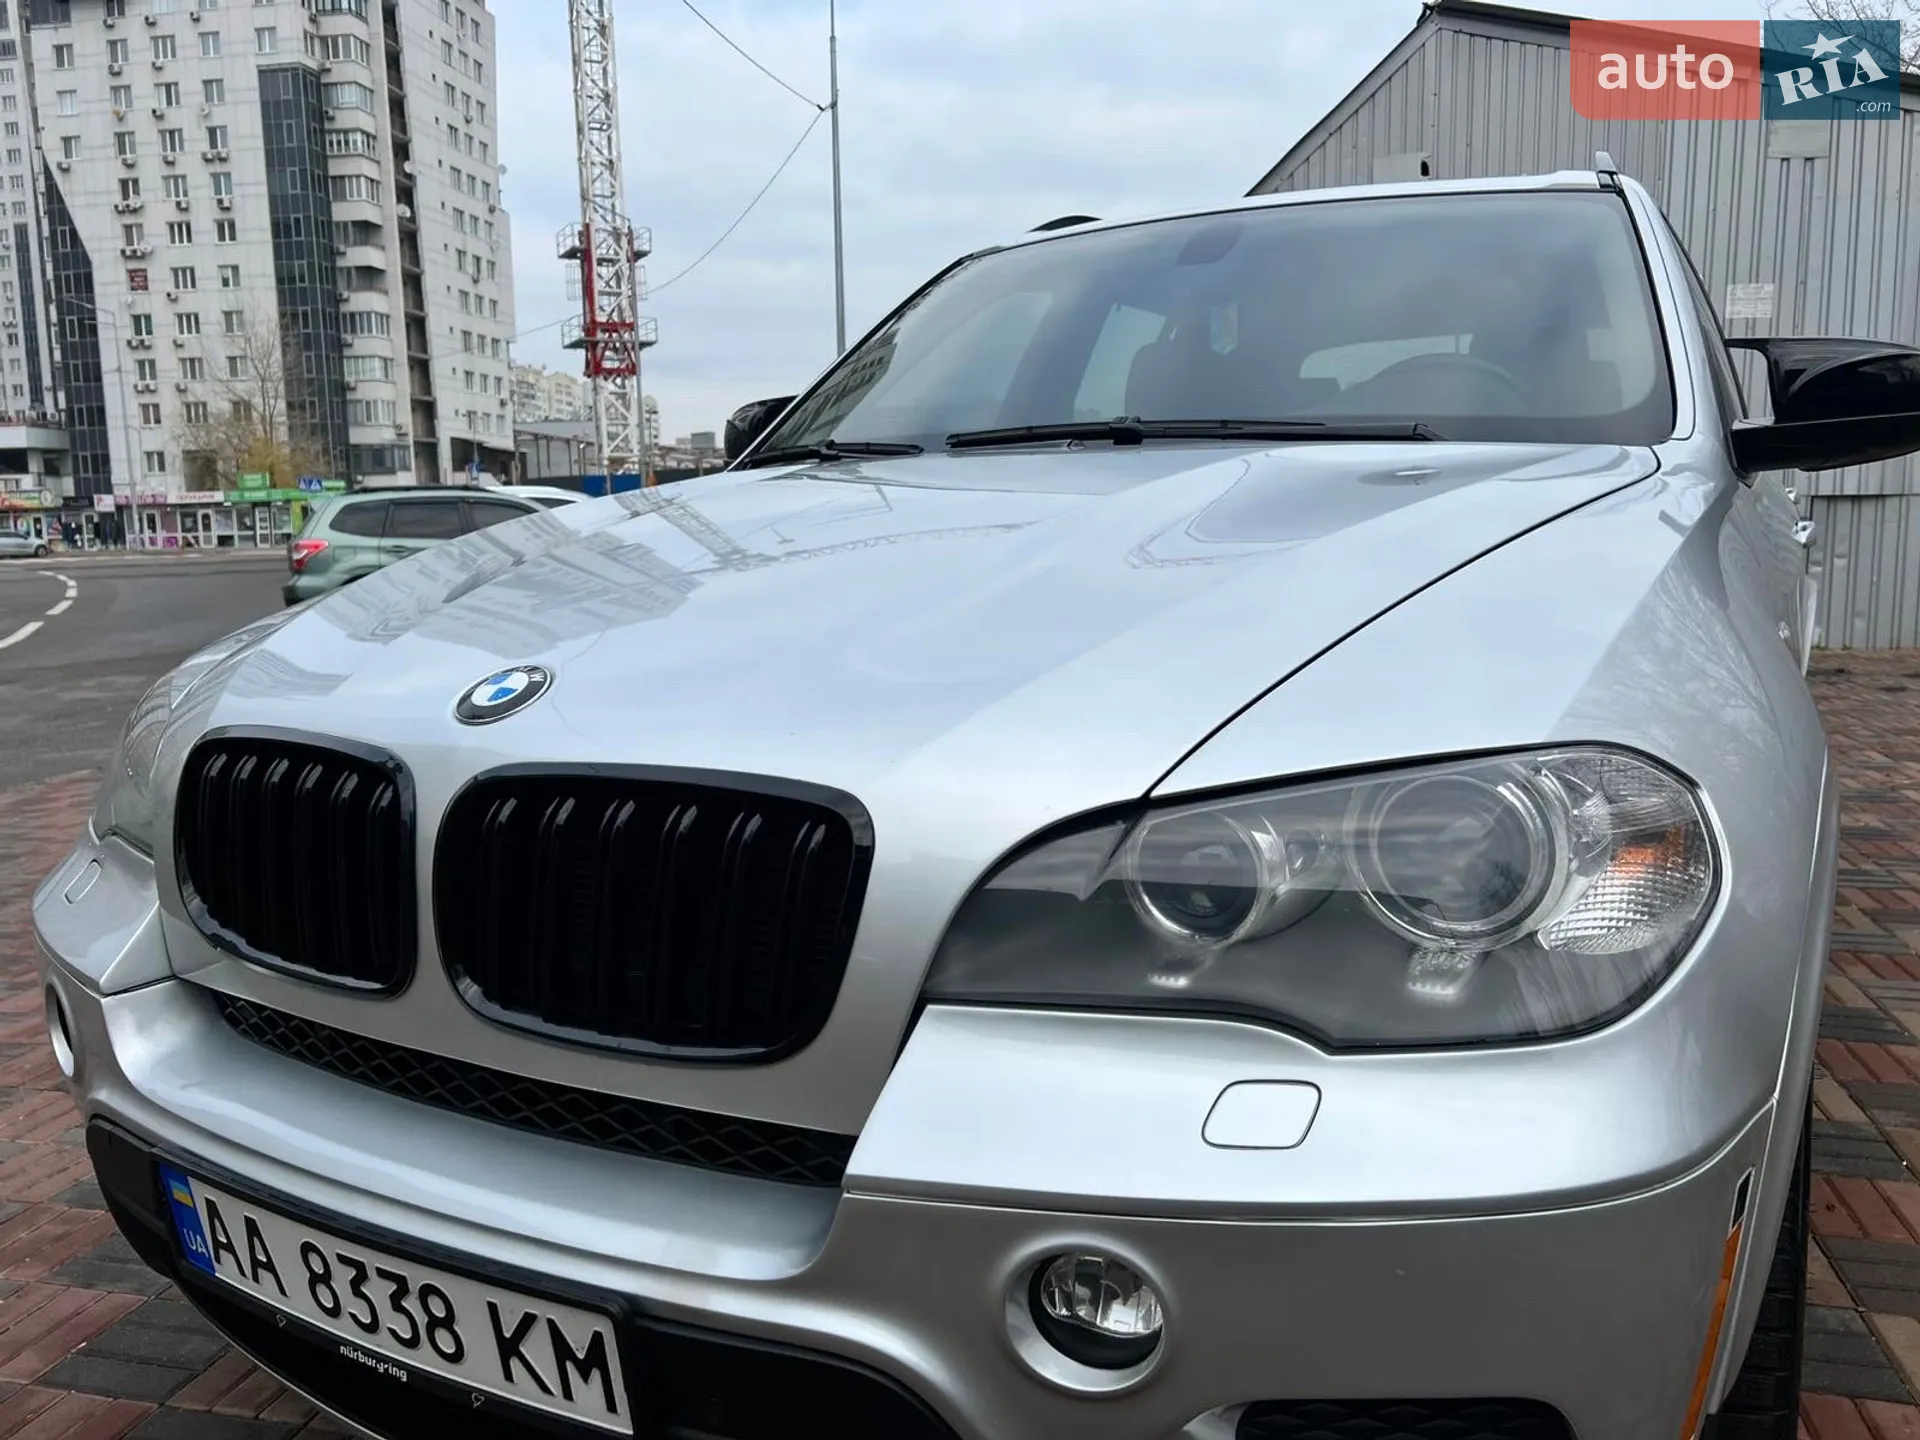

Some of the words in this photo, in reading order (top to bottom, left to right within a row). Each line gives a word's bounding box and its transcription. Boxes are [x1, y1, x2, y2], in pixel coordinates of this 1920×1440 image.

[183, 1227, 209, 1259] UA
[204, 1195, 289, 1298] AA
[299, 1238, 466, 1364] 8338
[486, 1299, 619, 1415] KM
